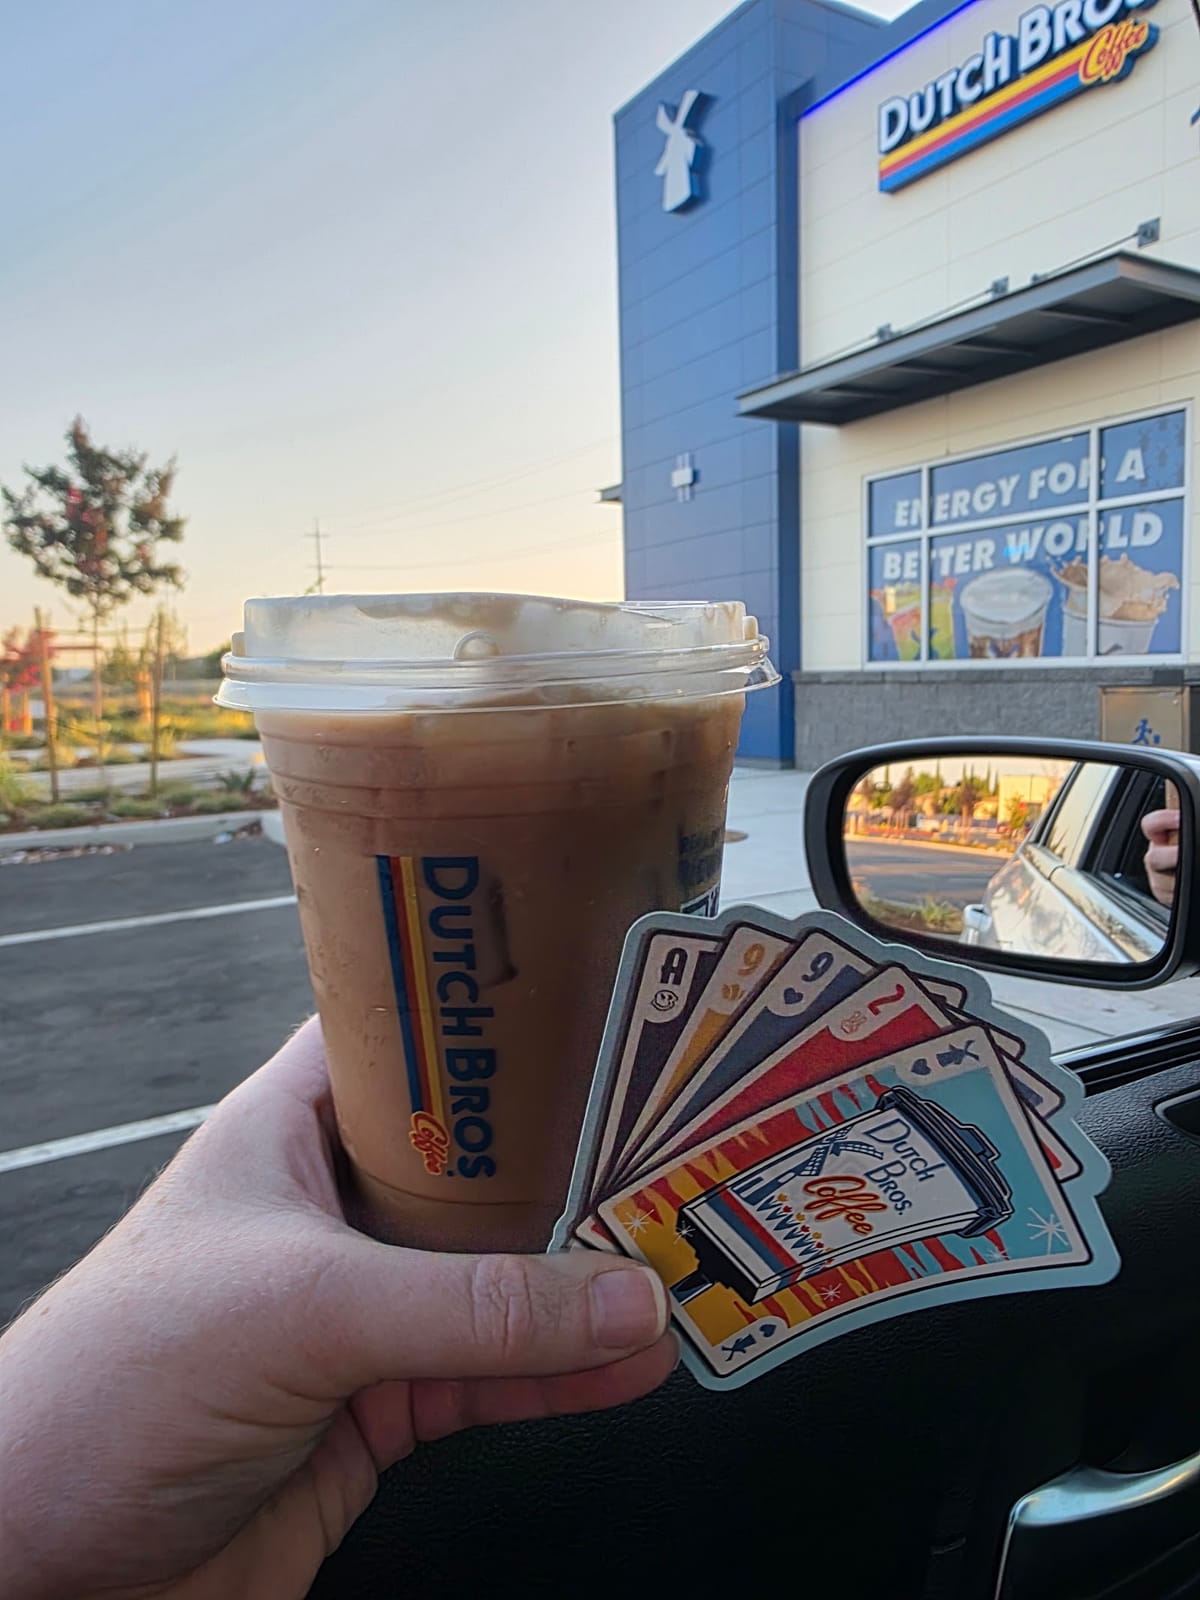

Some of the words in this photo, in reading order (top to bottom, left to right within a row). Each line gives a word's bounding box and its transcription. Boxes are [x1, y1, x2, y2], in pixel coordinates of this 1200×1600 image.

[1080, 19, 1149, 83] Coffee
[879, 32, 1012, 153] DUTCH
[1019, 0, 1145, 72] BRO
[1115, 447, 1146, 482] A
[883, 539, 996, 580] BETER
[421, 856, 495, 1036] DUTCH
[660, 947, 688, 986] A
[737, 943, 766, 977] 9
[801, 951, 835, 983] 9
[867, 983, 906, 1016] 2
[409, 1111, 449, 1175] Coffee
[803, 1175, 888, 1236] Coffee
